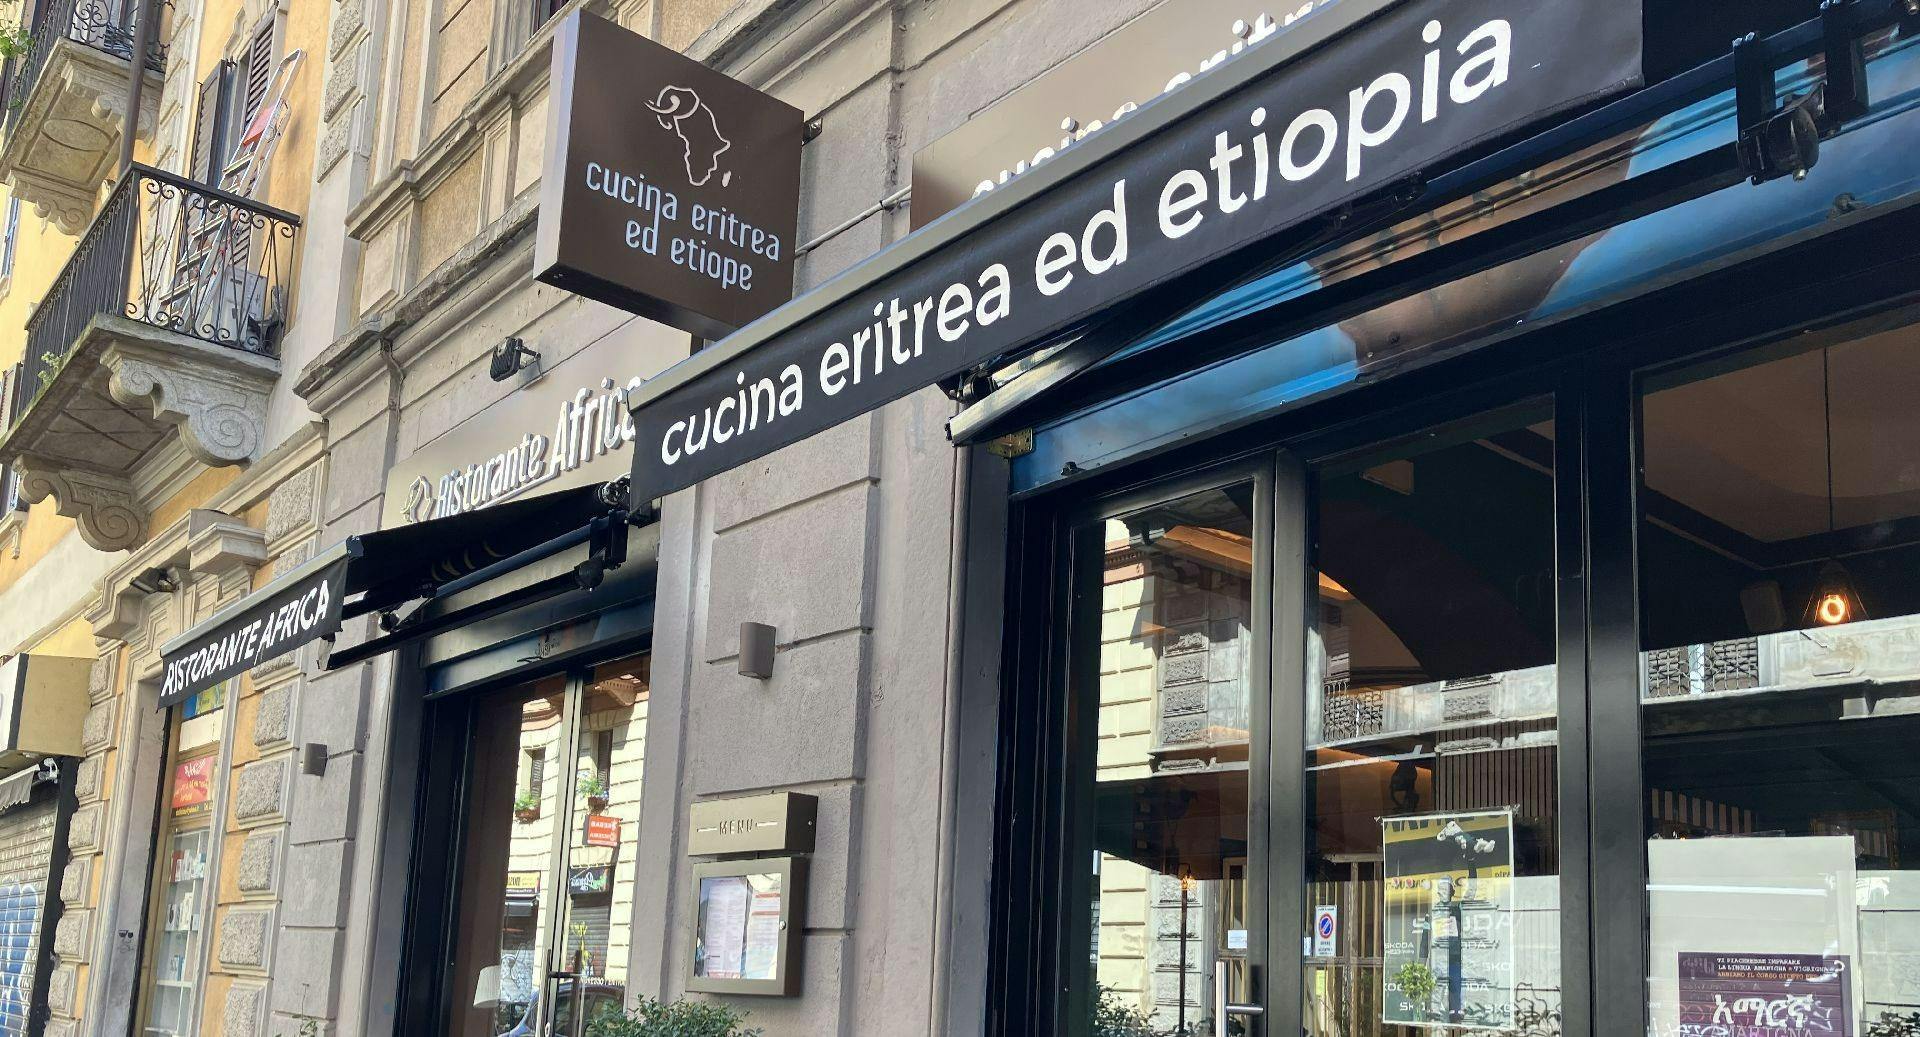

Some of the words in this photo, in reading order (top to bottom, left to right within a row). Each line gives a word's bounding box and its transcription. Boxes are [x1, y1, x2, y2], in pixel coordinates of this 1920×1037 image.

[585, 161, 678, 221] cucina
[691, 203, 781, 262] eritrea
[625, 215, 660, 256] ed
[670, 237, 753, 291] etiope
[660, 363, 803, 466] cucina
[819, 262, 1011, 397] eritrea
[1034, 178, 1129, 297] ed
[1157, 18, 1512, 240] etiopia
[435, 432, 548, 520] Ristorante
[160, 618, 262, 697] RISTORANTE
[254, 578, 330, 666] AFRICA
[719, 818, 753, 836] MENU
